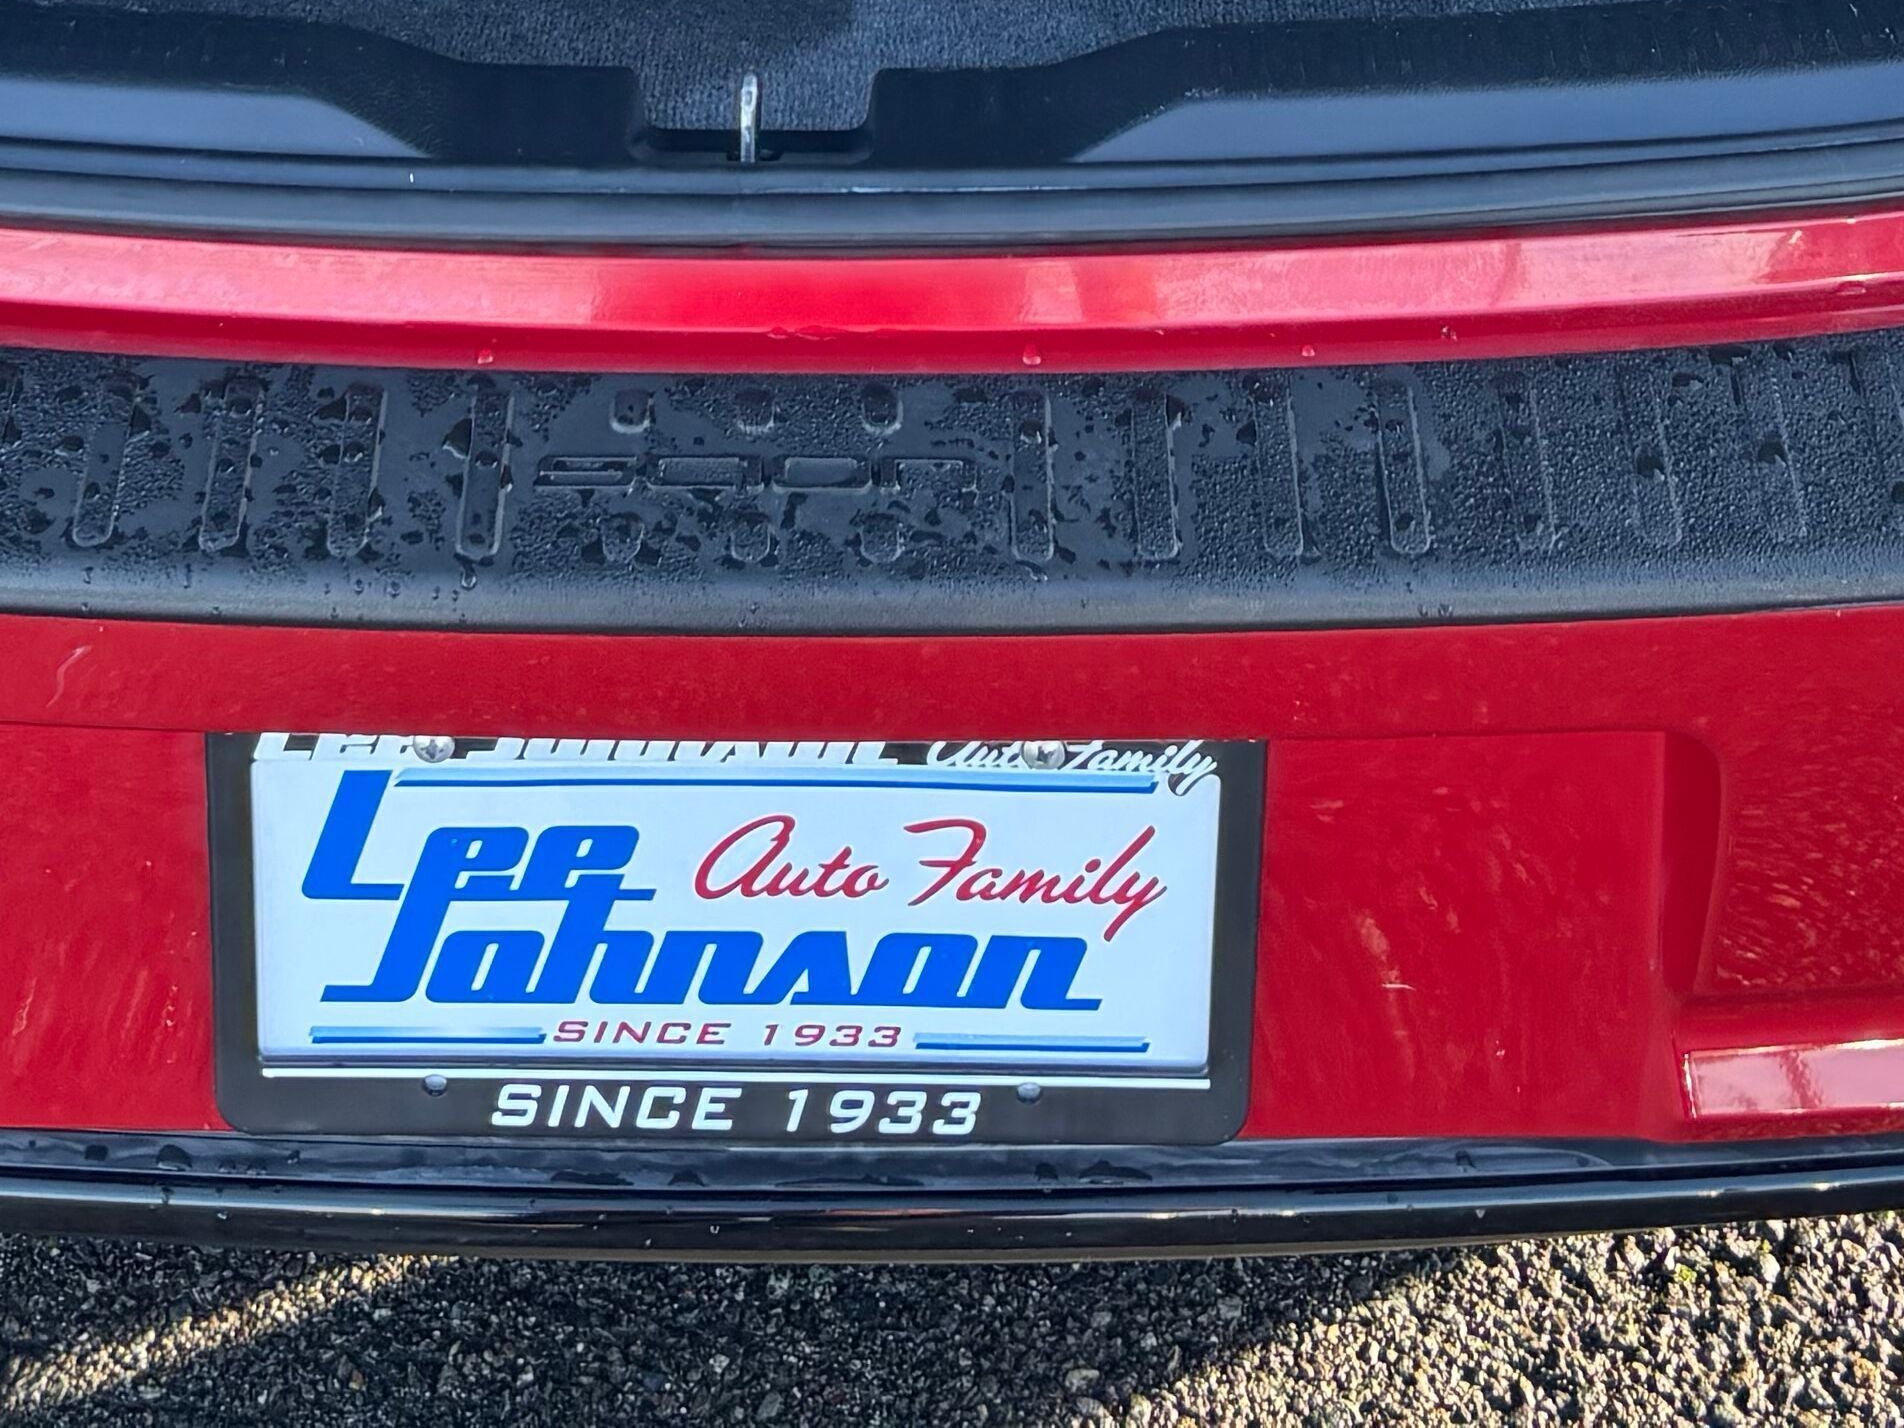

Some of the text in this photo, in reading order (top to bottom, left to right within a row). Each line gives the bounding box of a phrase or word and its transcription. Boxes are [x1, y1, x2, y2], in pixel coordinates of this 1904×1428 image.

[301, 769, 1168, 942] Lee Auto Family
[319, 874, 1103, 1011] Johnson
[552, 1021, 902, 1048] SINCE 1933
[491, 1083, 983, 1135] SINCE 1933
